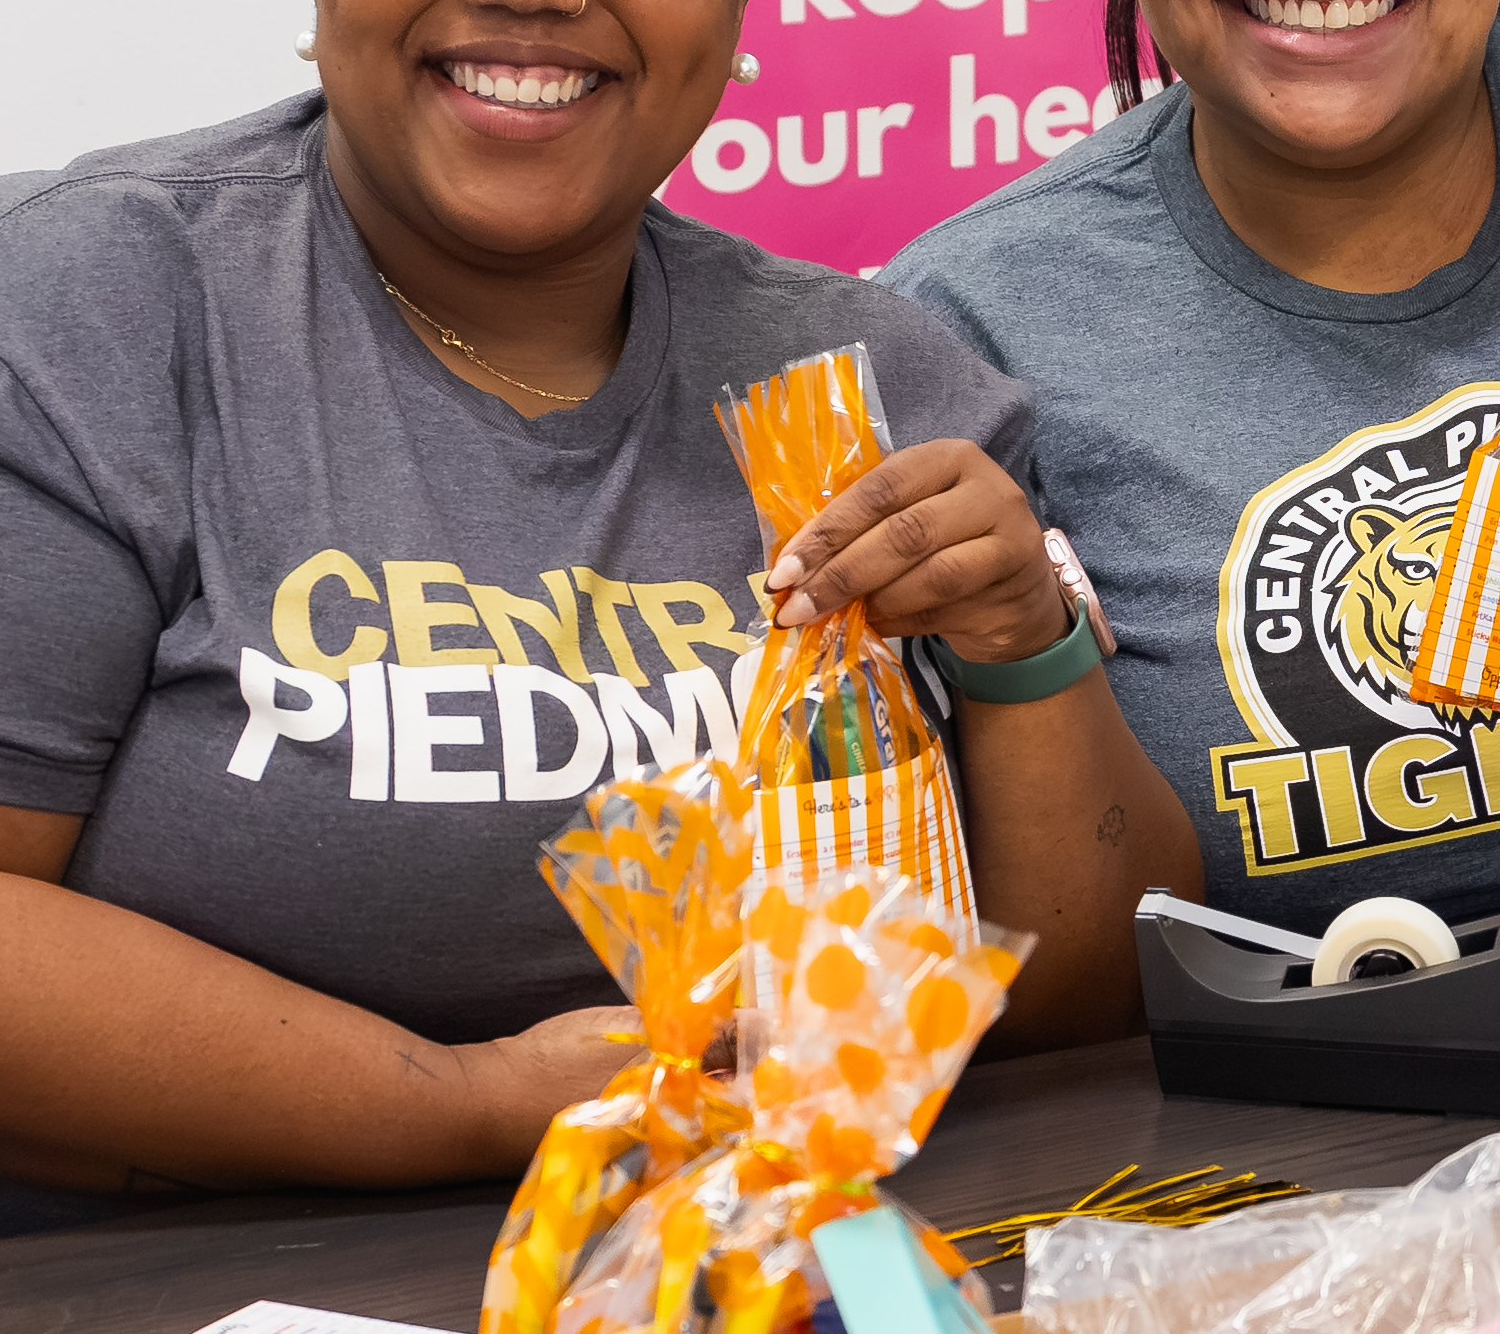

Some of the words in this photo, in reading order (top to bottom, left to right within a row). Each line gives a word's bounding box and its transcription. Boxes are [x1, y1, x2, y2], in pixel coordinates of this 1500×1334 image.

[652, 100, 914, 200] our
[272, 548, 775, 687] CENTR
[1256, 449, 1429, 654] CENTRAL
